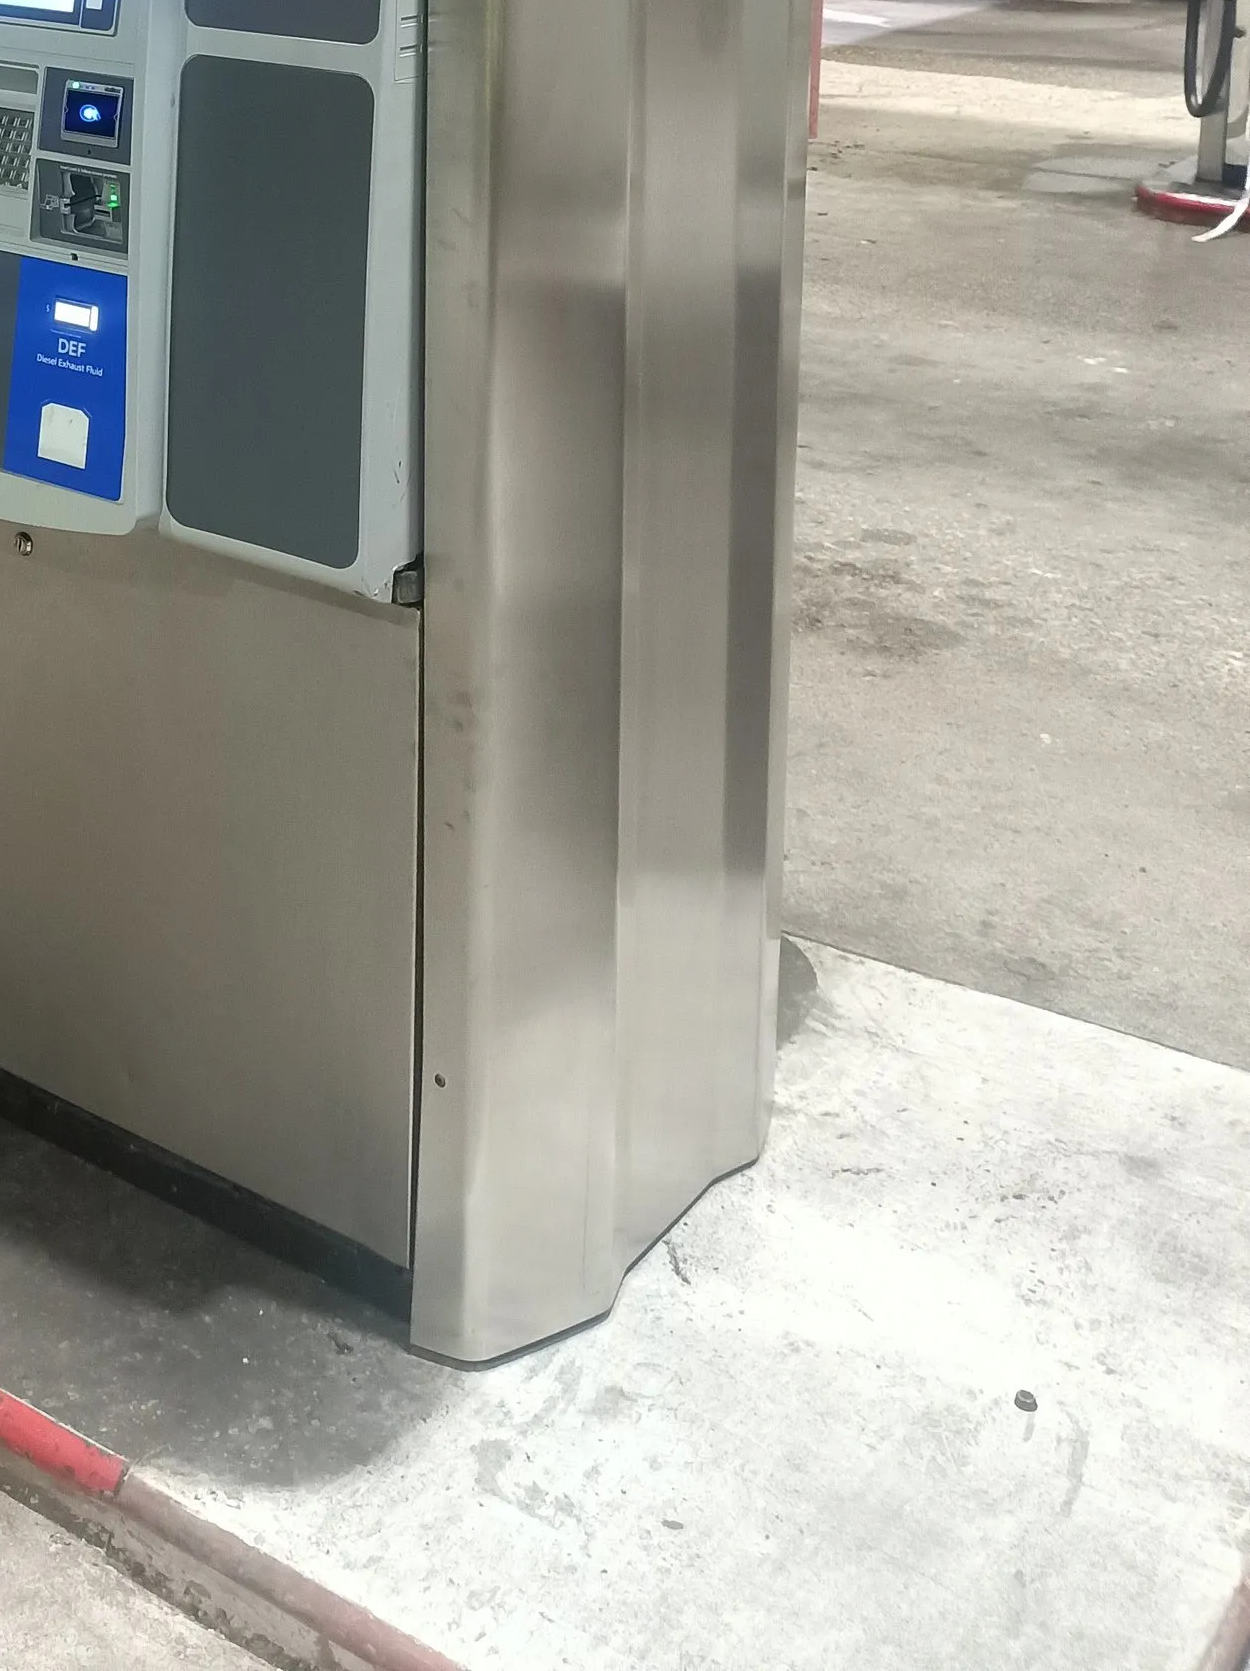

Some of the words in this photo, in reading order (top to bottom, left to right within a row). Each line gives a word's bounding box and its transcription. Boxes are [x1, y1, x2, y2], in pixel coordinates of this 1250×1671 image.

[57, 337, 87, 357] DEF
[36, 353, 57, 366] Diesel
[58, 358, 85, 373] Exhaust
[85, 365, 103, 377] Fluid
